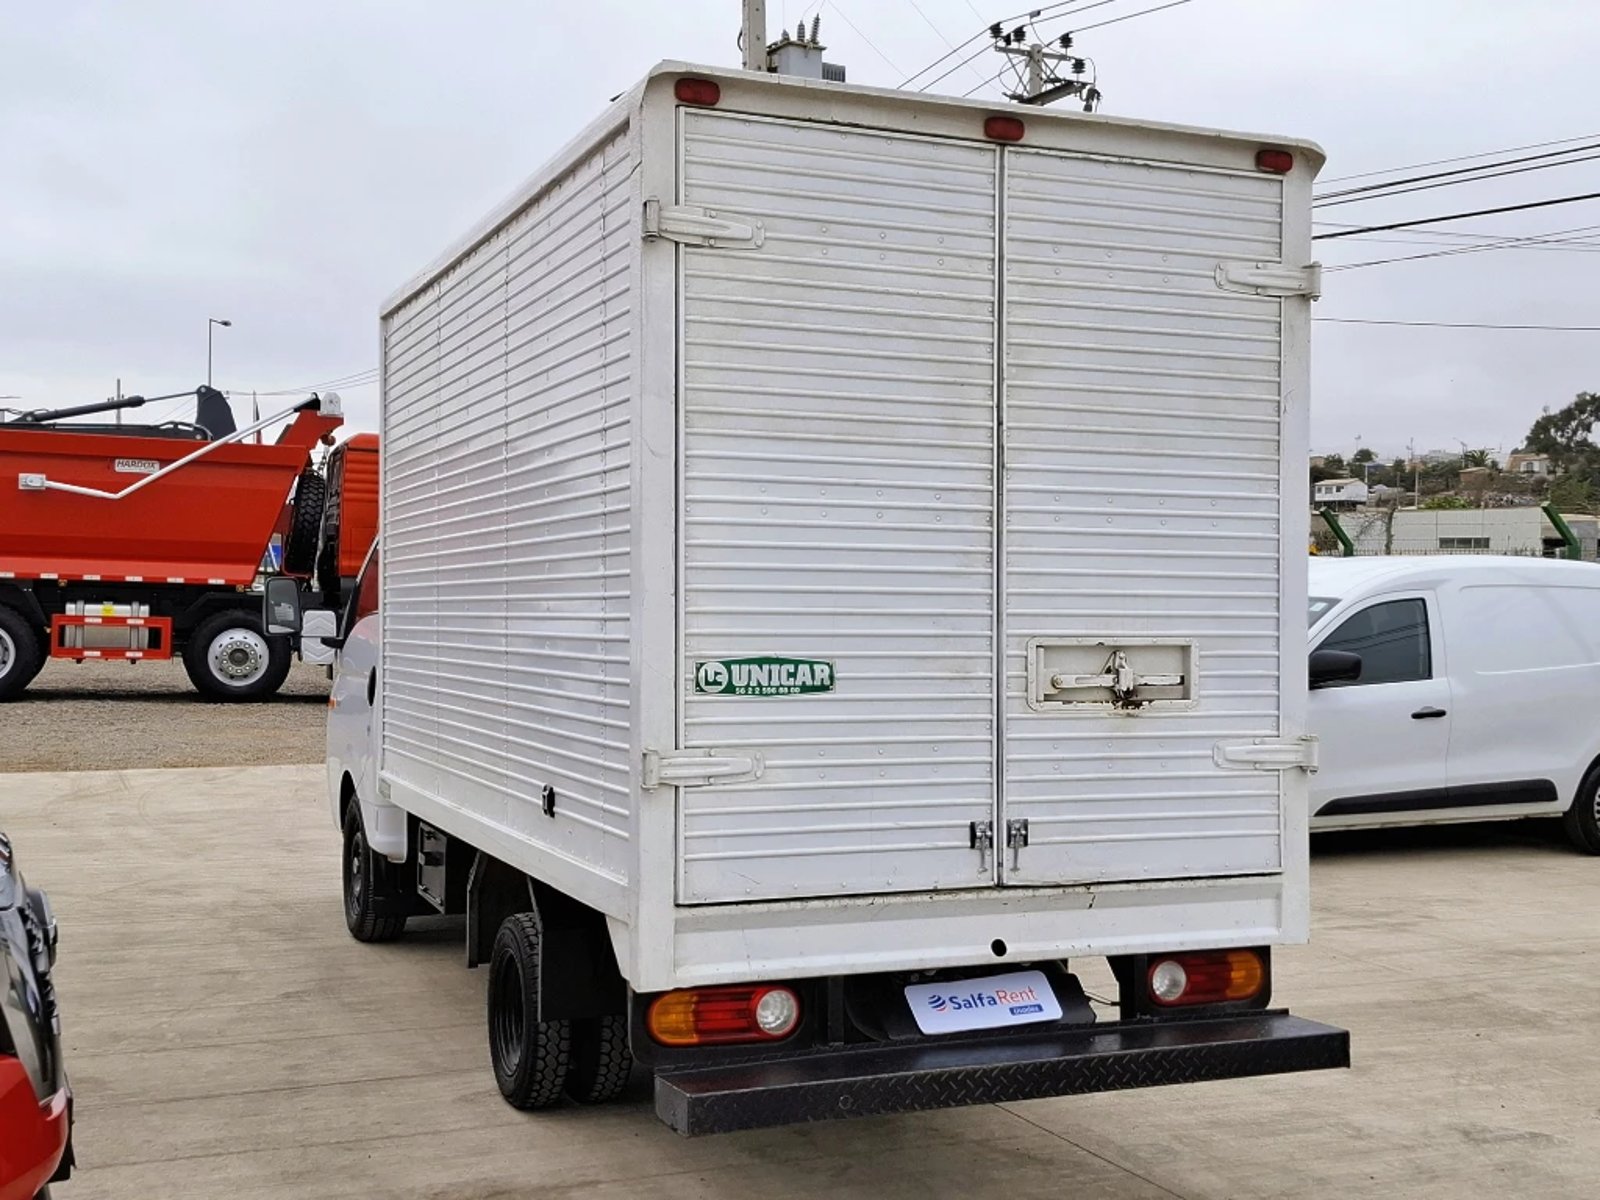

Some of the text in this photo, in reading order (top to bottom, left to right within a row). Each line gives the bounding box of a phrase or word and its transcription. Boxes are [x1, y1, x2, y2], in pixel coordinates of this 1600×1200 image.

[116, 460, 155, 469] HARDOX
[731, 664, 831, 687] UNICAR
[949, 986, 1037, 1010] SalfaRent
